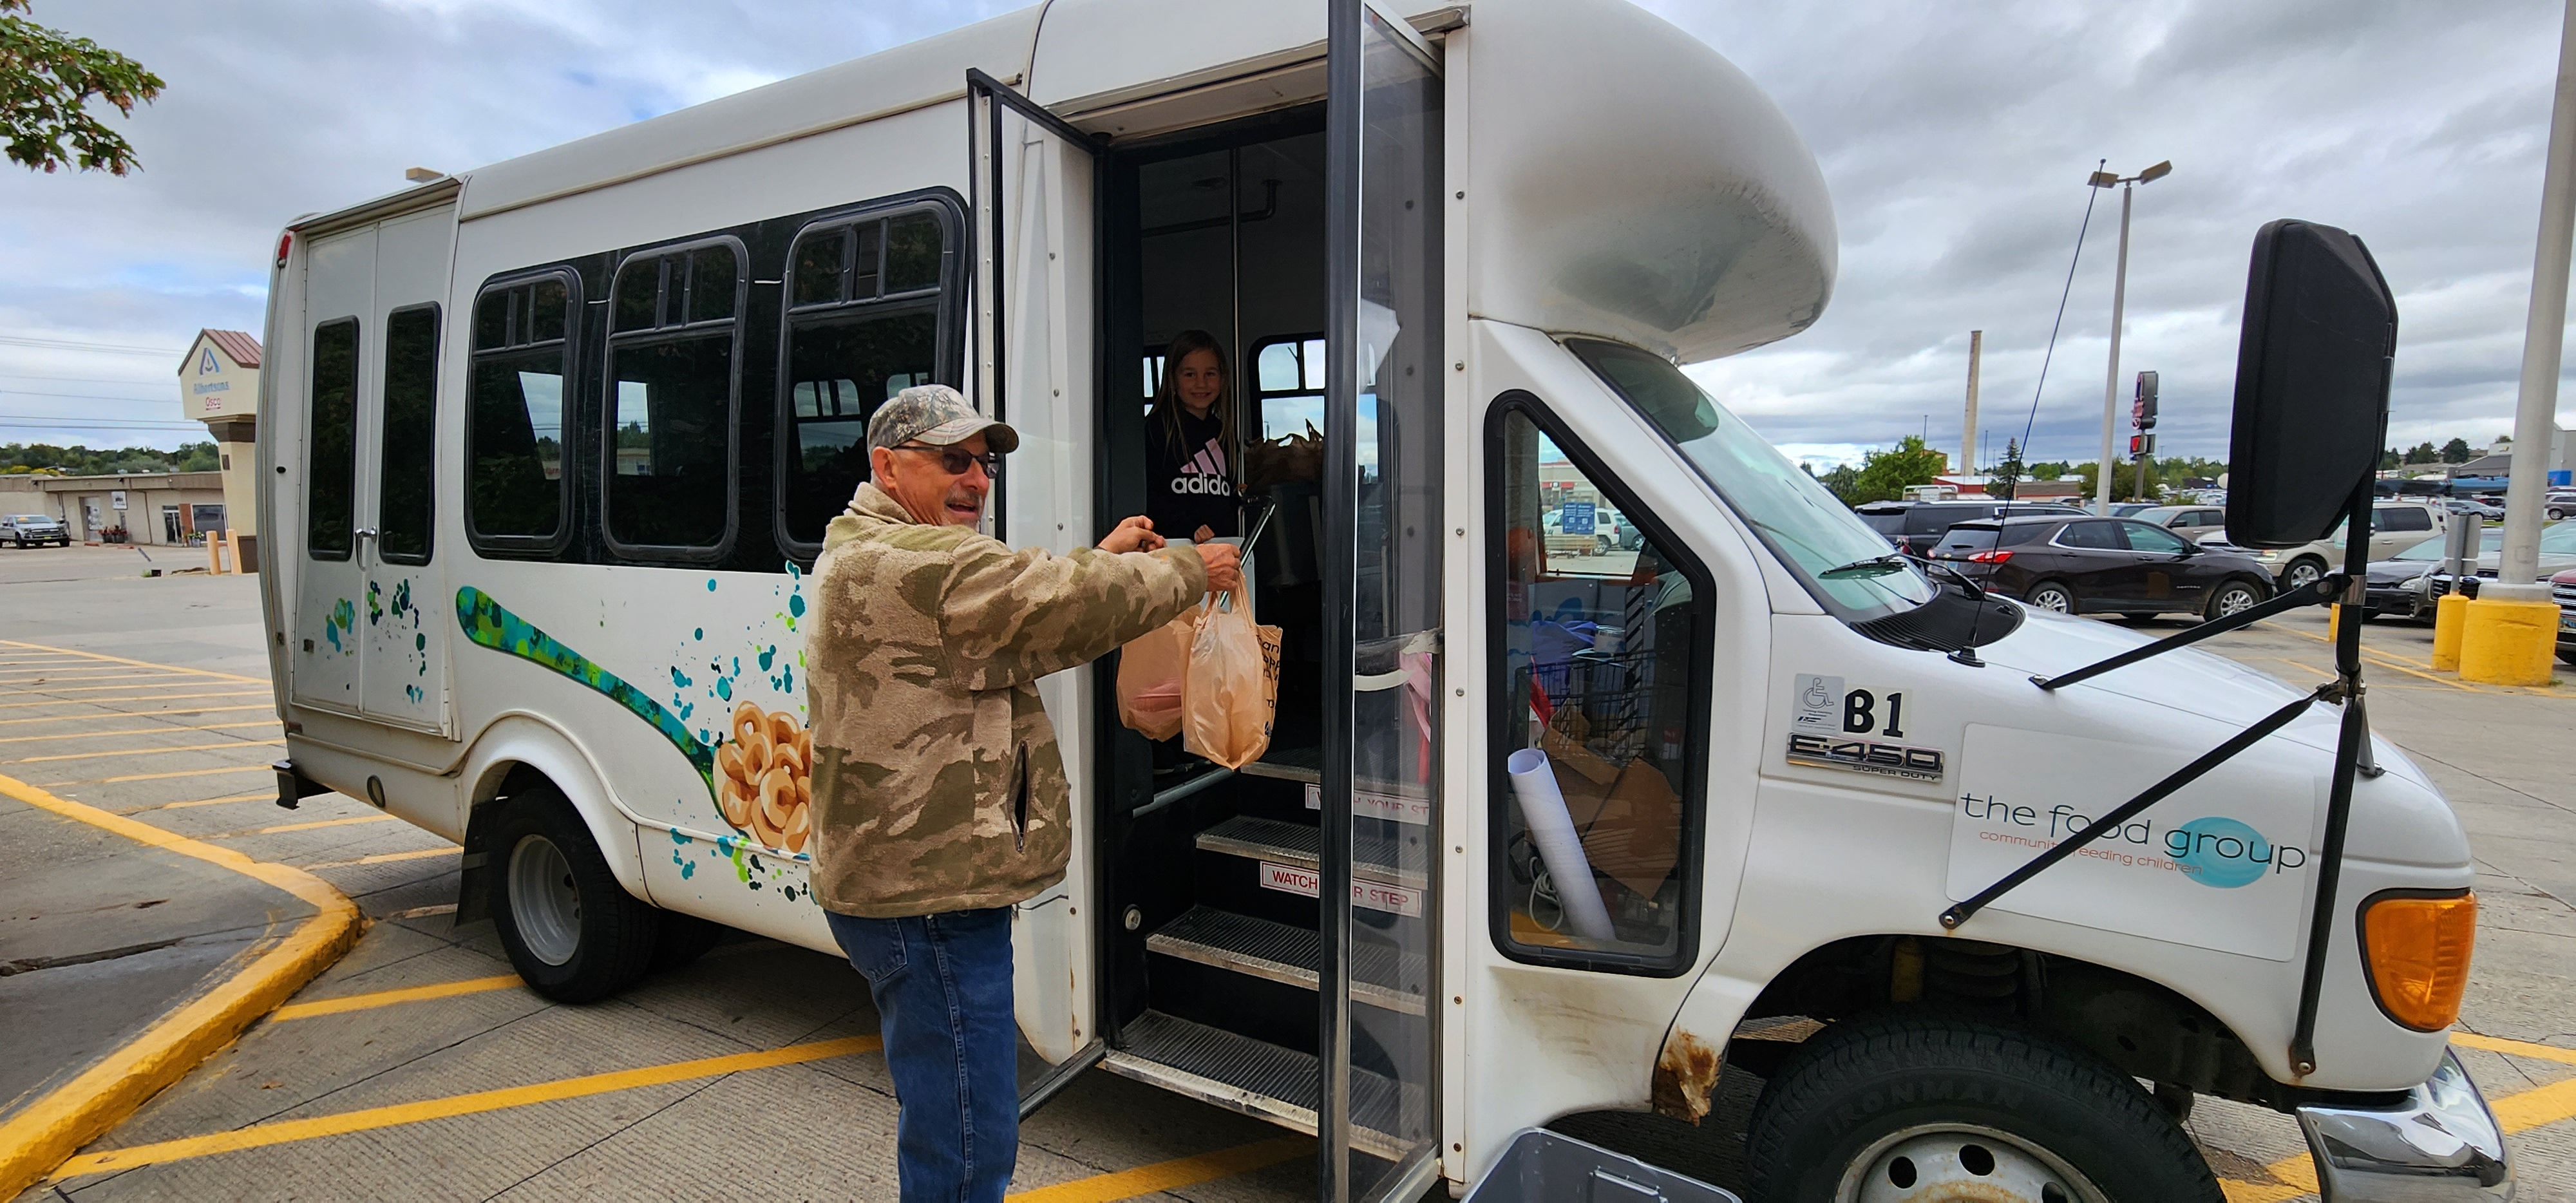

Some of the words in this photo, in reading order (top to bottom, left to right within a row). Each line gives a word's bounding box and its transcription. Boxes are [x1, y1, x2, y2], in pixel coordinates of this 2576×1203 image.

[1171, 473, 1230, 497] adida
[1843, 688, 1904, 738] B1
[1853, 765, 1897, 776] SUPER
[1900, 771, 1938, 781] DUTY
[1960, 793, 2036, 826] the
[2163, 829, 2306, 874] group
[1980, 831, 2060, 850] communit
[2073, 847, 2133, 866] eeding
[2137, 855, 2202, 875] children
[1273, 869, 1318, 890] WATCH
[1370, 889, 1409, 906] STEP
[1825, 1079, 2024, 1135] IRONMAN
